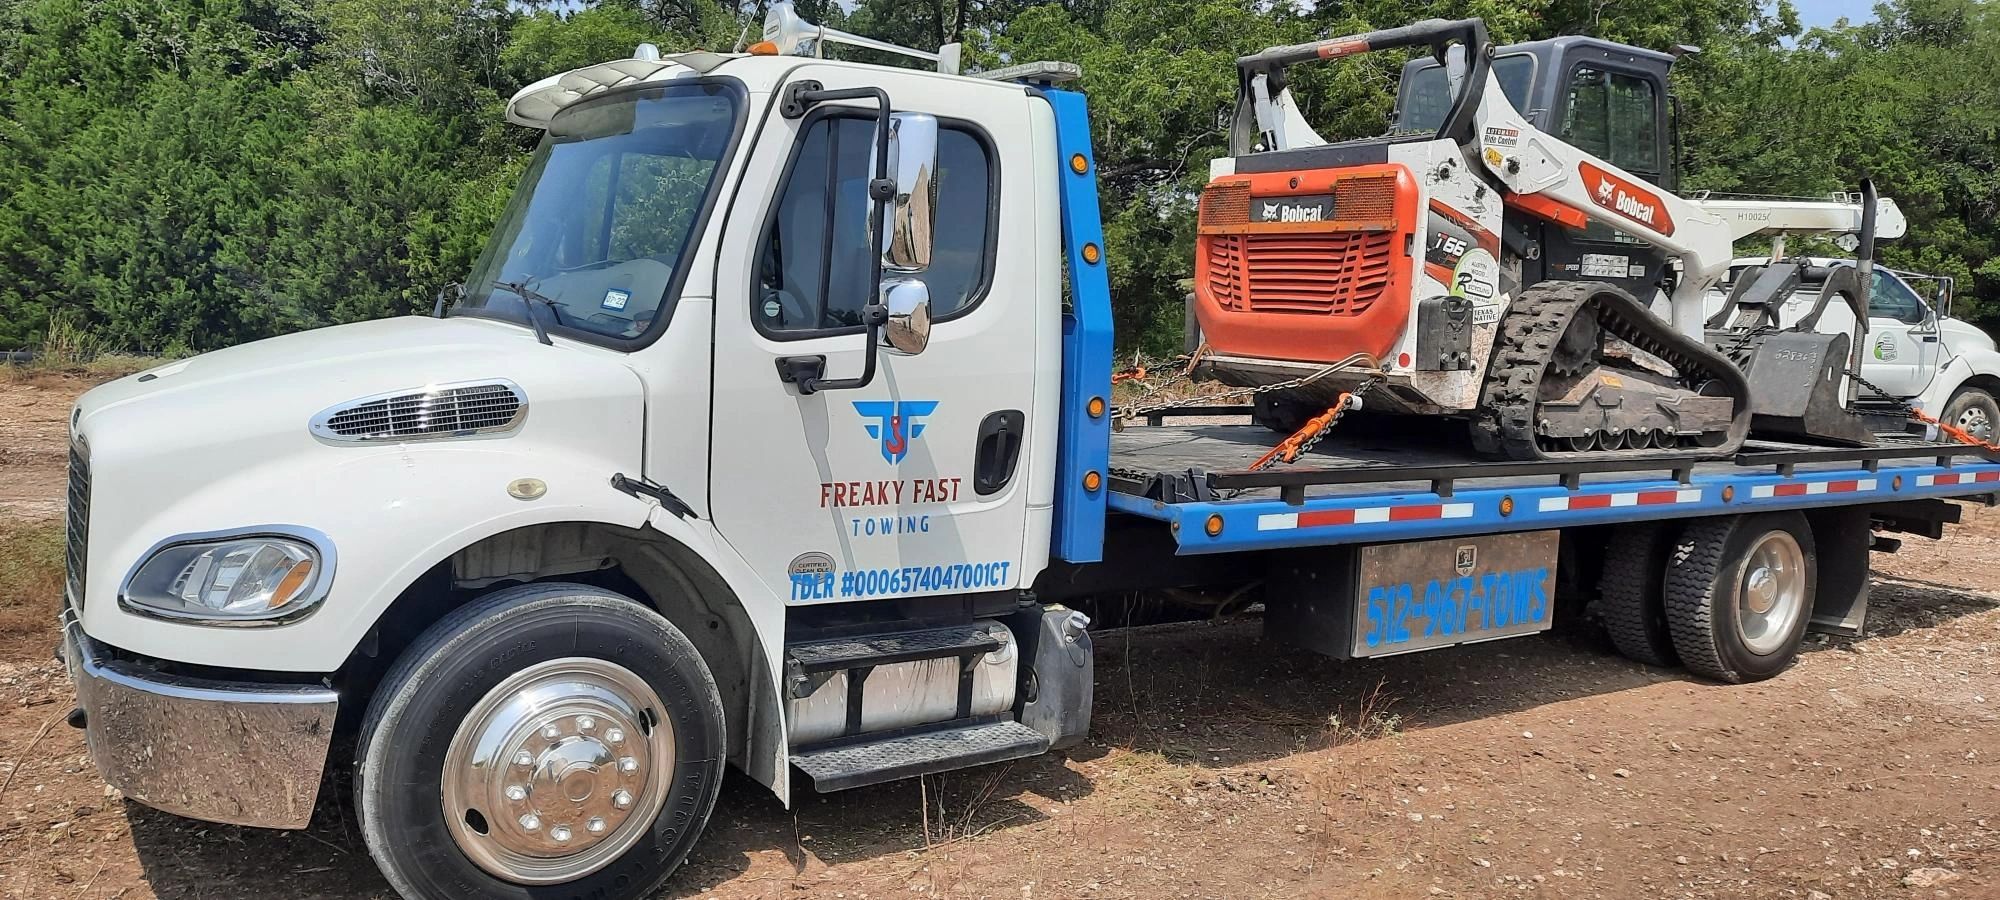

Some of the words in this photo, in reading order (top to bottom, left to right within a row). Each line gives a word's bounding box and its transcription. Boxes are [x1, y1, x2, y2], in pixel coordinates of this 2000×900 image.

[1281, 205, 1322, 222] Bobcat
[1615, 190, 1654, 224] Bobcat
[820, 480, 905, 508] FREAKY
[913, 478, 962, 503] FAST
[852, 515, 929, 536] TOWING
[789, 573, 835, 601] TDLR
[841, 561, 1010, 597] #0006574047001CT
[1366, 568, 1548, 648] 512-967-TOWS
